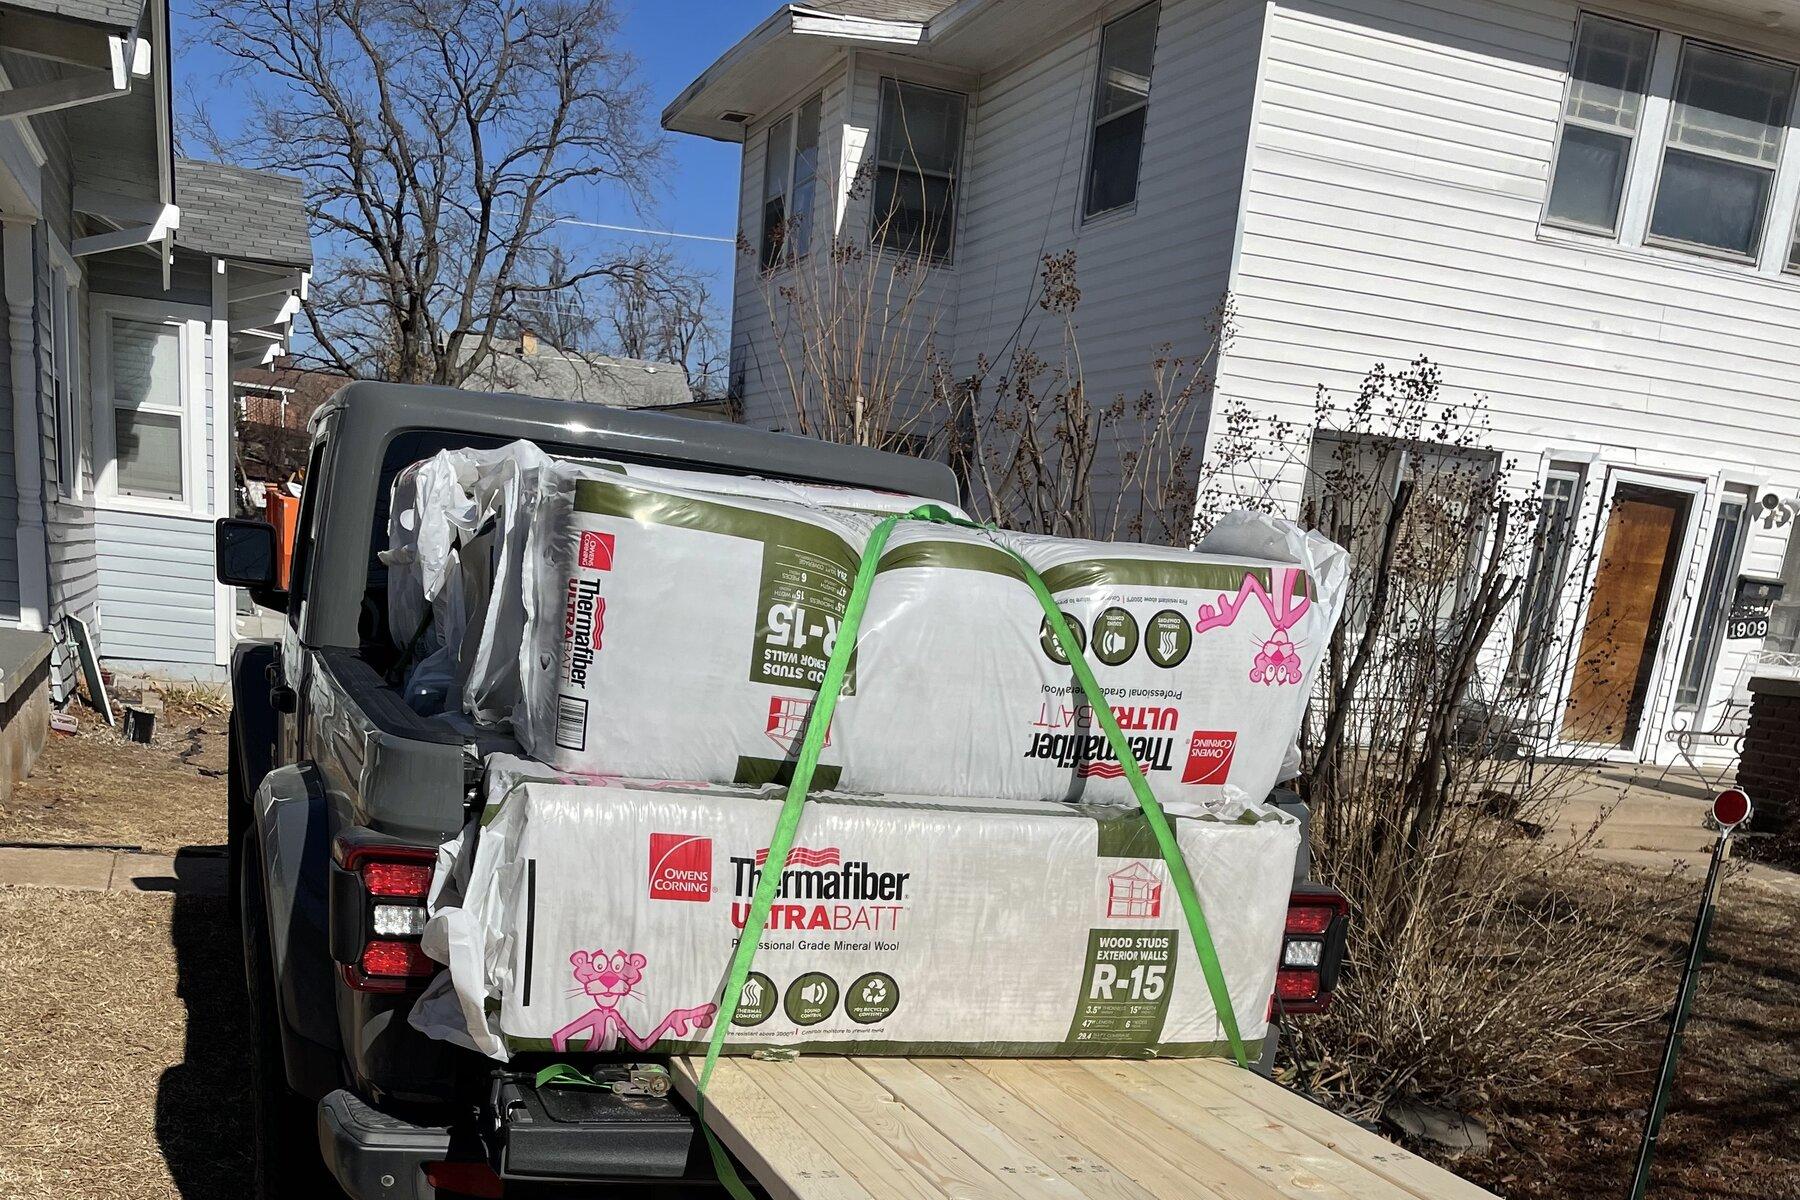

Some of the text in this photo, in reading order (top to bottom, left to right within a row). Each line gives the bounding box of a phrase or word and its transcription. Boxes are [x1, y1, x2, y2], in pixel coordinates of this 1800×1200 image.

[582, 533, 591, 566] CORNING
[588, 540, 597, 567] OWENS
[801, 572, 807, 583] 6
[562, 577, 579, 685] ULTRABATT
[571, 578, 601, 690] Thermafiber
[766, 603, 842, 658] R-15
[1729, 619, 1768, 639] 1909
[764, 648, 798, 664] WALLS
[763, 663, 805, 679] STUDS
[1129, 688, 1183, 700] Professional
[1193, 738, 1233, 750] CORNING
[1191, 748, 1224, 759] OWENS
[664, 868, 708, 882] OWENS
[730, 857, 911, 901] Thrmafiber
[654, 879, 708, 893] CORNING
[730, 902, 904, 931] UTRABATT
[731, 938, 901, 951] Pssional Grade Mineral Wool
[1099, 937, 1169, 948] WOOD STUDS
[1096, 950, 1168, 961] EXTERIOR WALLS
[1089, 963, 1167, 1000] R-15
[1125, 1020, 1131, 1028] 6
